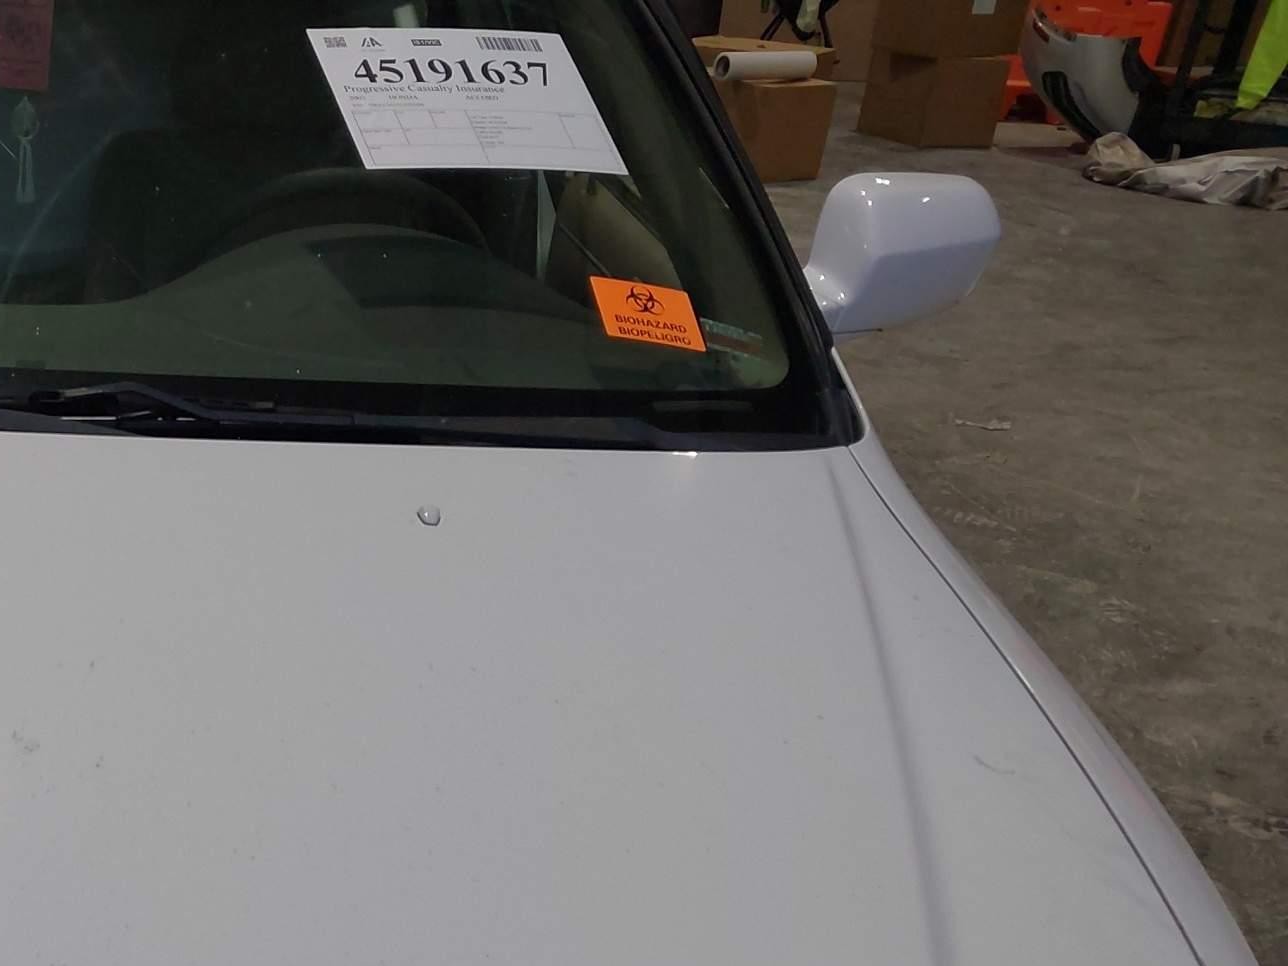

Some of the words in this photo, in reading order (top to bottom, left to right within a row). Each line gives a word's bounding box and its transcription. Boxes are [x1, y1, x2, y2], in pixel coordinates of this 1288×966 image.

[353, 58, 548, 87] 45191637
[343, 85, 405, 95] Progressive
[407, 85, 453, 94] Casualty
[455, 85, 505, 94] Insurance
[614, 313, 688, 334] BIOHAZARD
[618, 325, 692, 346] BIOPELIGRO
